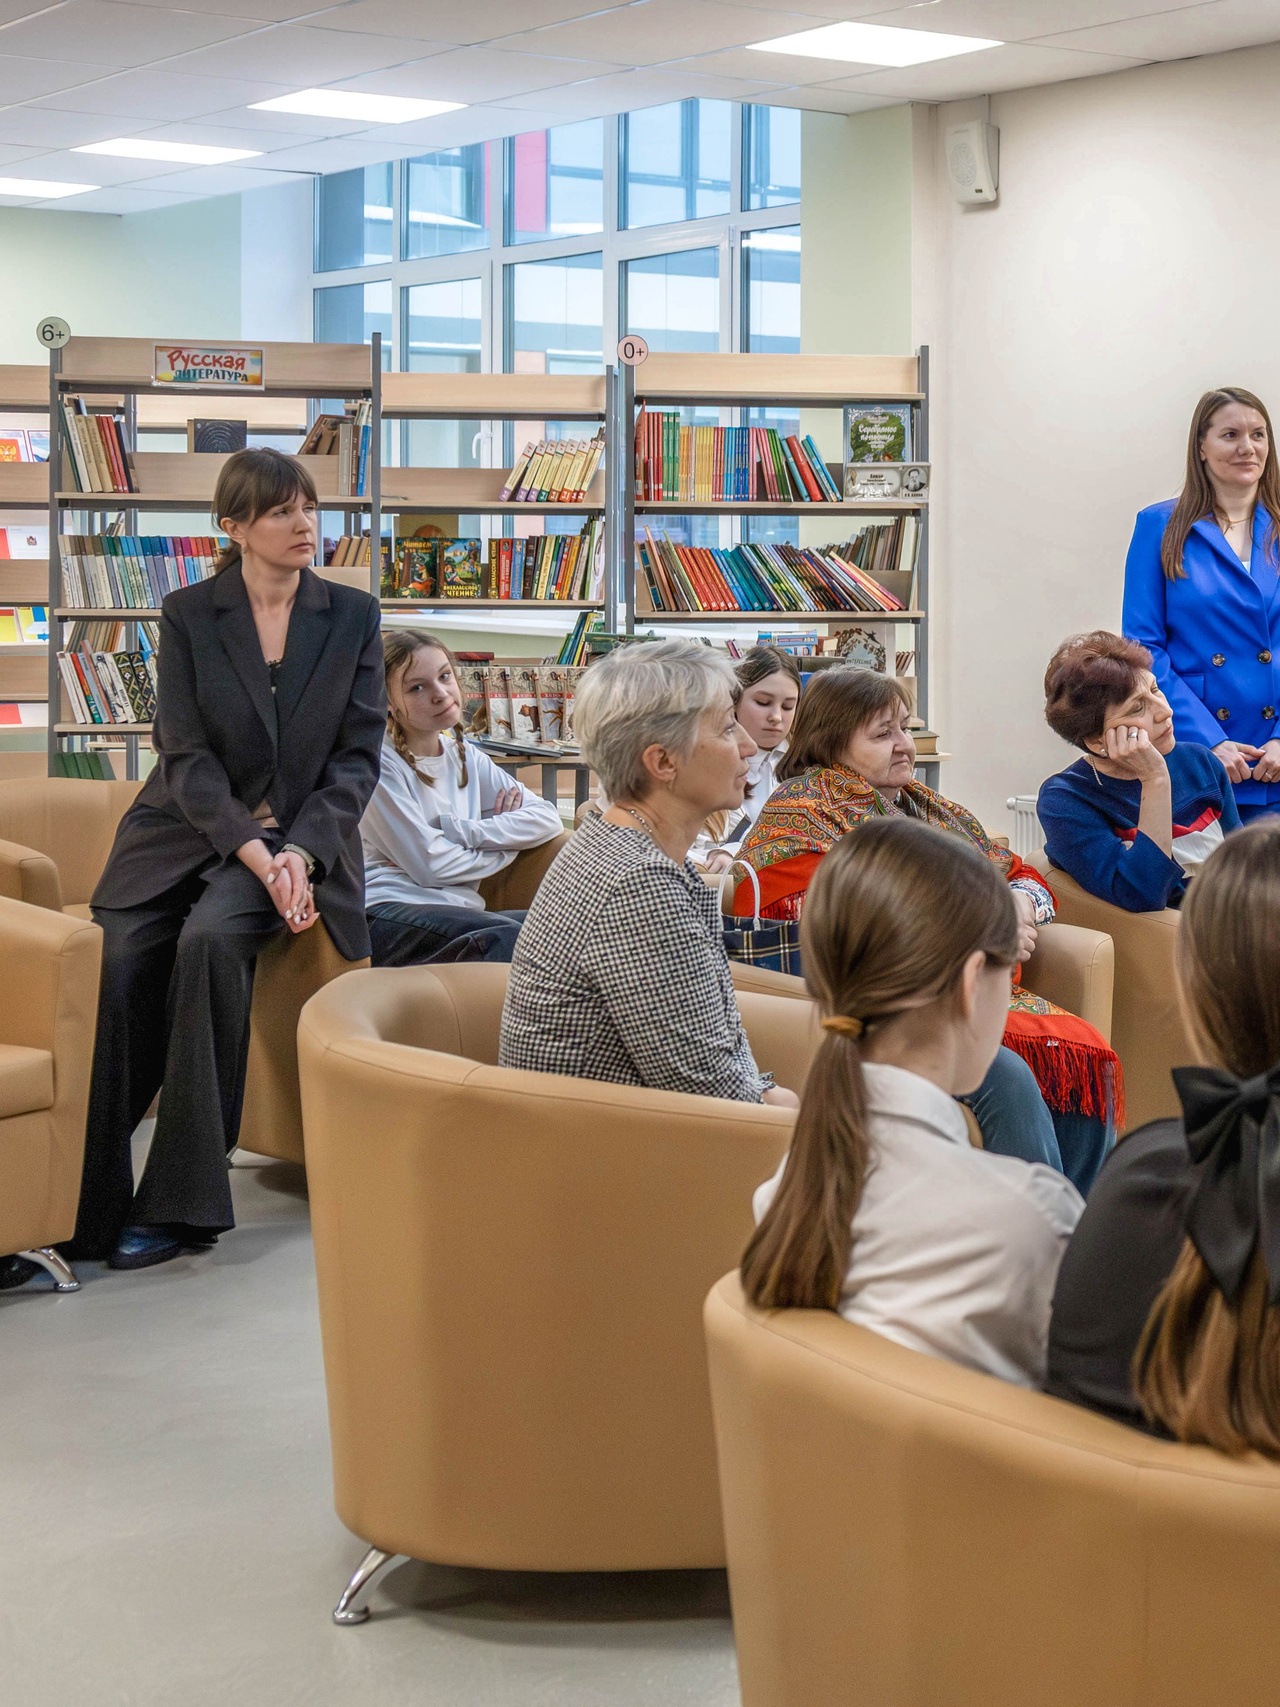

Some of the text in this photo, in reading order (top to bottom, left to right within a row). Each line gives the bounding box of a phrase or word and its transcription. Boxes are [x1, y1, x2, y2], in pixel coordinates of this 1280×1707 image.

[42, 324, 65, 341] 6+
[624, 342, 645, 359] 0+
[167, 349, 246, 371] Русская
[175, 368, 249, 382] ЛИТЕРАТУРА
